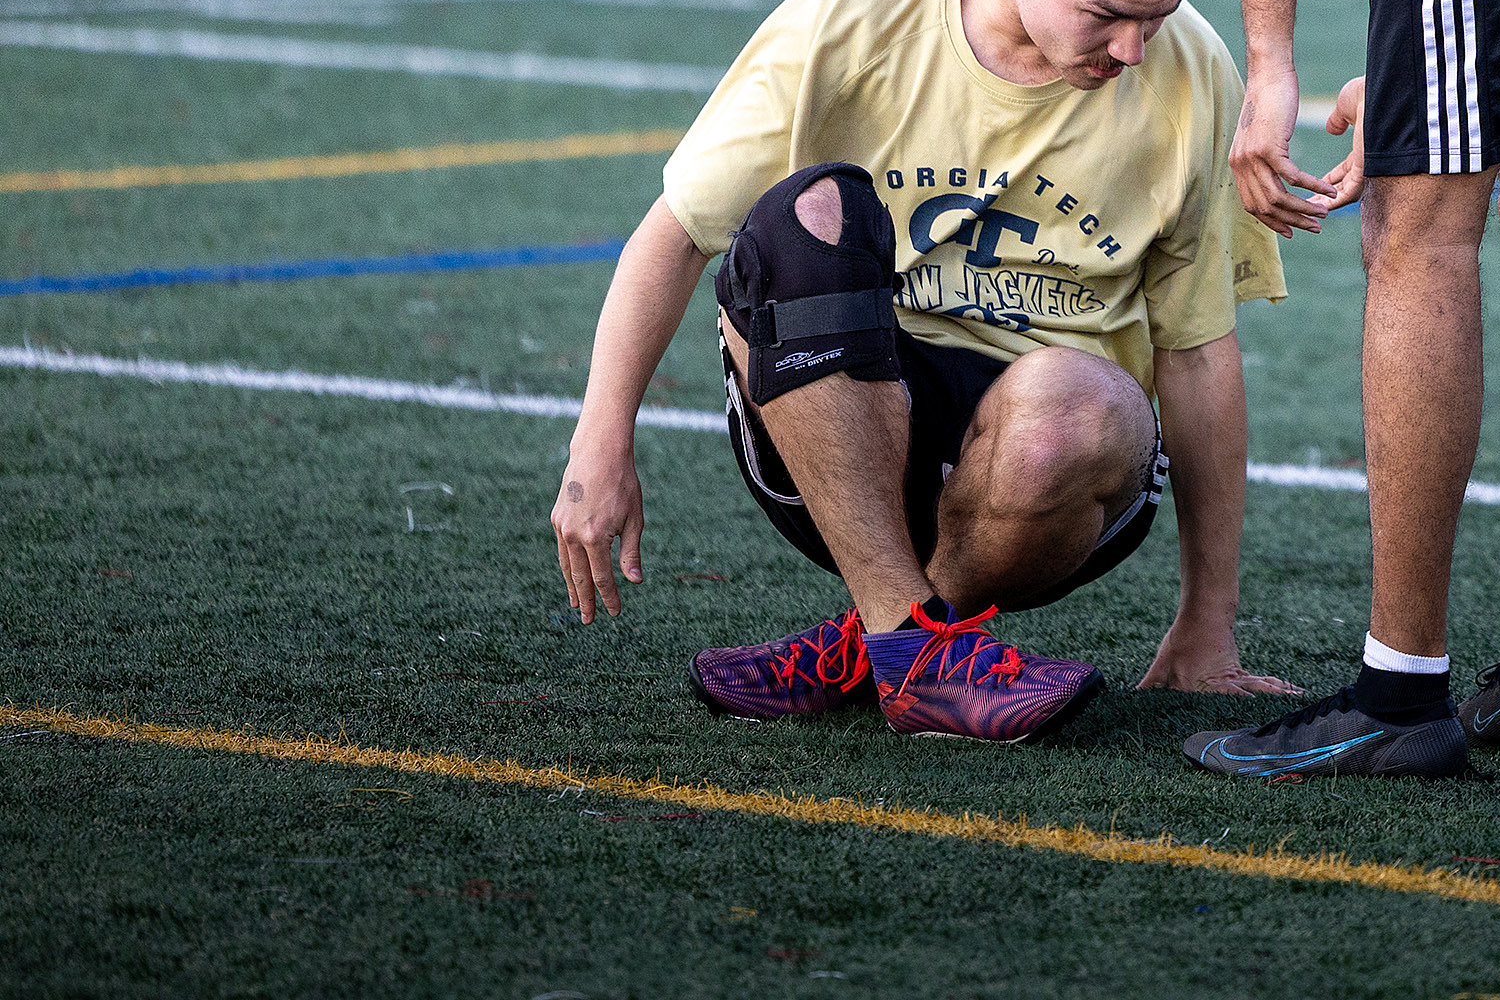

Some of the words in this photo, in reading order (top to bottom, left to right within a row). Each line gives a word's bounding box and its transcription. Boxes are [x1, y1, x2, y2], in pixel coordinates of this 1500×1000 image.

[886, 167, 1009, 189] ORGIA
[1034, 175, 1122, 258] TECH
[807, 351, 841, 367] DRYTEX
